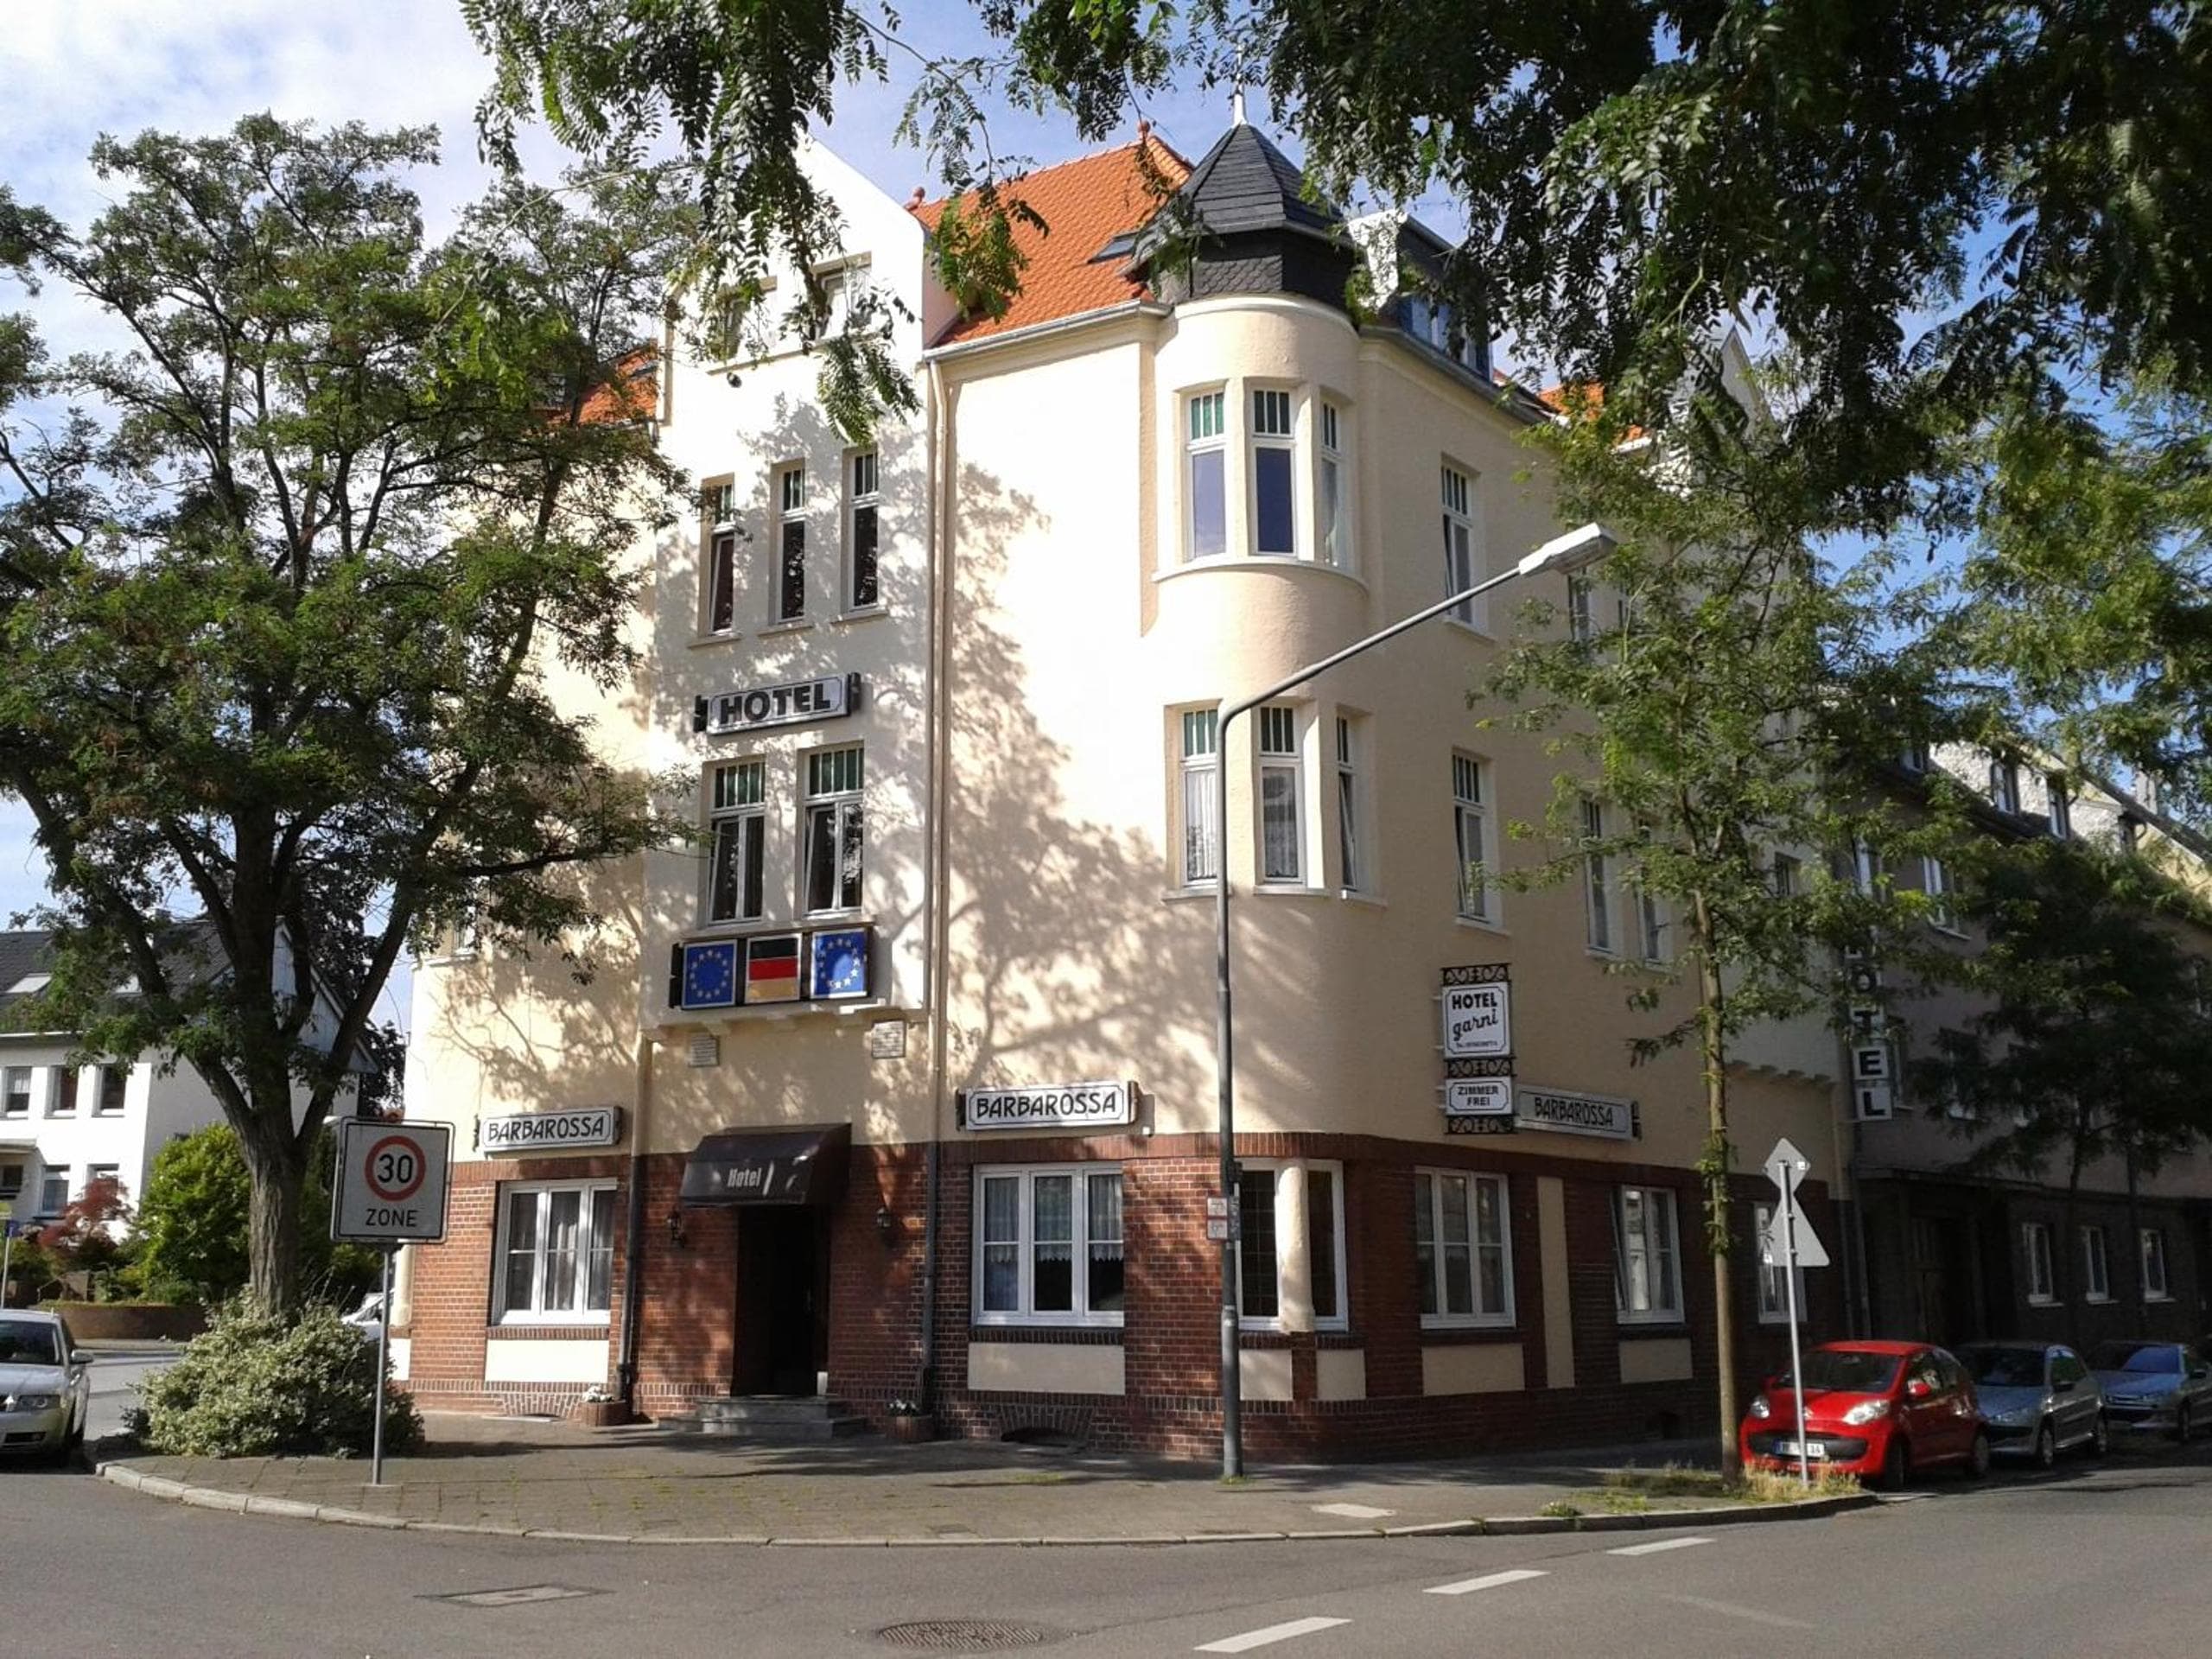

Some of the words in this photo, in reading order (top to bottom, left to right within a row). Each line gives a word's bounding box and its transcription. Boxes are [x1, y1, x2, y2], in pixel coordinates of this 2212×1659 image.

[720, 682, 830, 725] HOTEL
[1452, 992, 1497, 1009] HOTEL
[1452, 1008, 1498, 1041] garni
[1458, 1085, 1499, 1095] ZIMMER
[1467, 1096, 1490, 1106] FREI
[977, 1091, 1116, 1119] BARBAROSSA
[1535, 1097, 1613, 1126] BARBAROSSA
[489, 1116, 604, 1141] BARBAROSSA
[377, 1154, 414, 1183] 30
[727, 1167, 762, 1188] Hotel
[365, 1209, 418, 1227] ZONE
